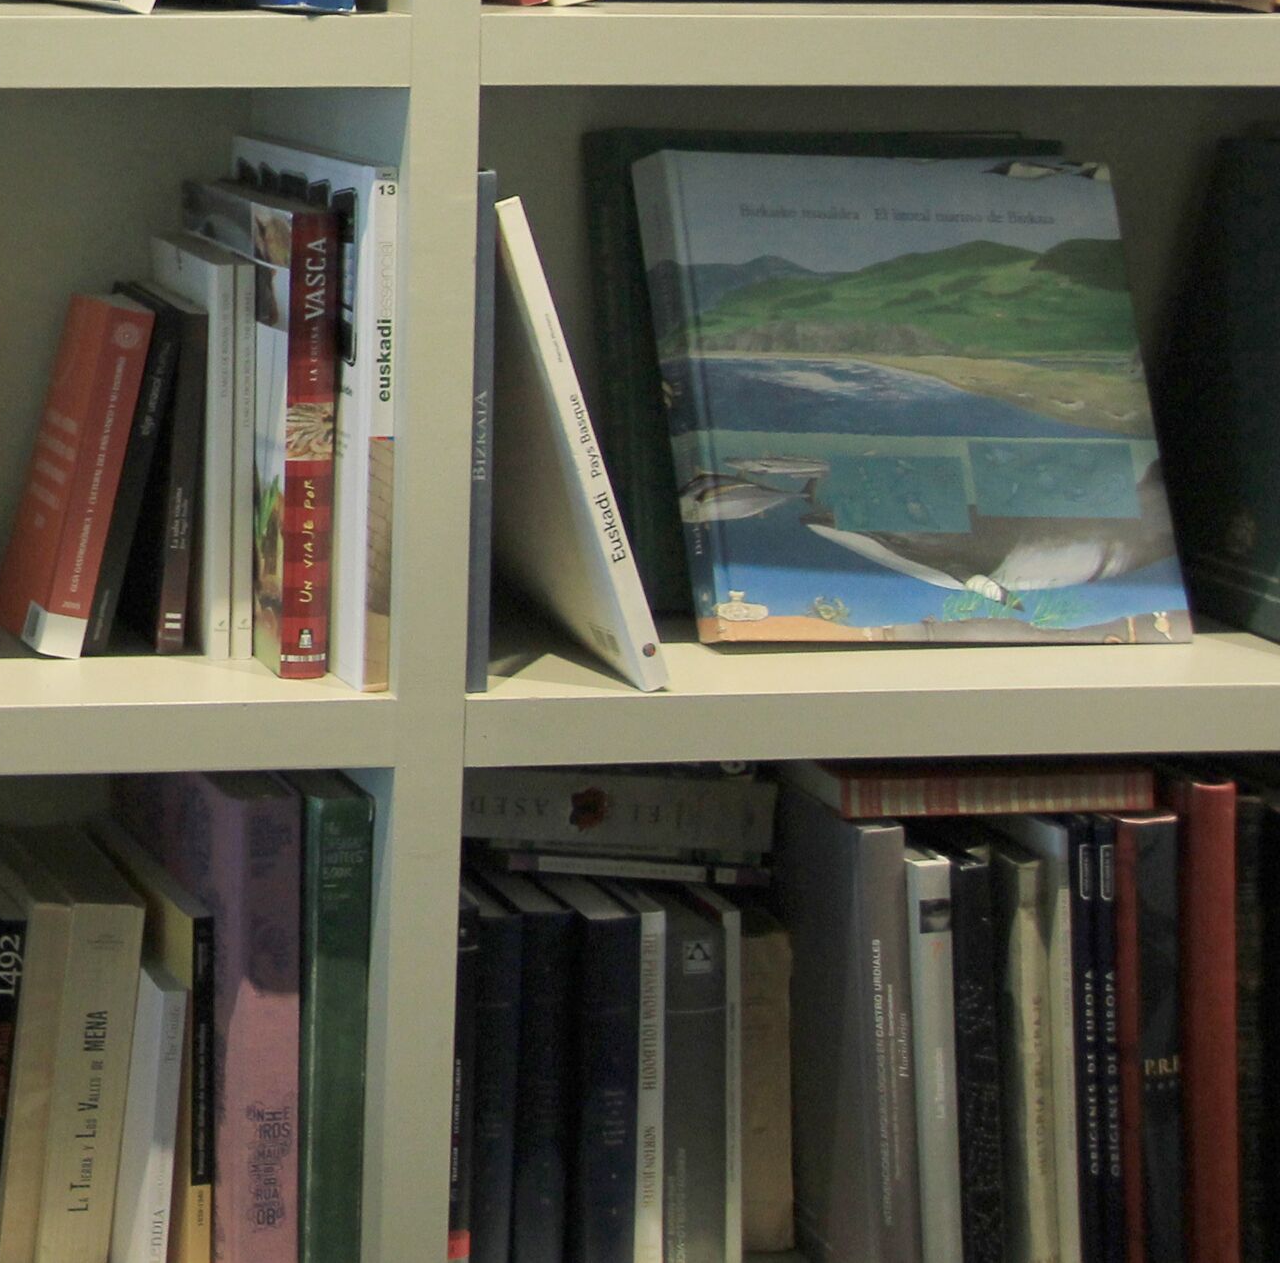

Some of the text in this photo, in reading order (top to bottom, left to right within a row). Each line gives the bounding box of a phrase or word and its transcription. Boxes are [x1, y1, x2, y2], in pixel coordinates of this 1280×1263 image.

[379, 184, 396, 195] 13
[303, 236, 327, 320] VASCA
[309, 368, 317, 381] LA
[472, 390, 488, 480] BIZKAIA
[570, 392, 626, 563] Euskadi Pays Basque
[300, 479, 315, 602] UN VIAJE POR
